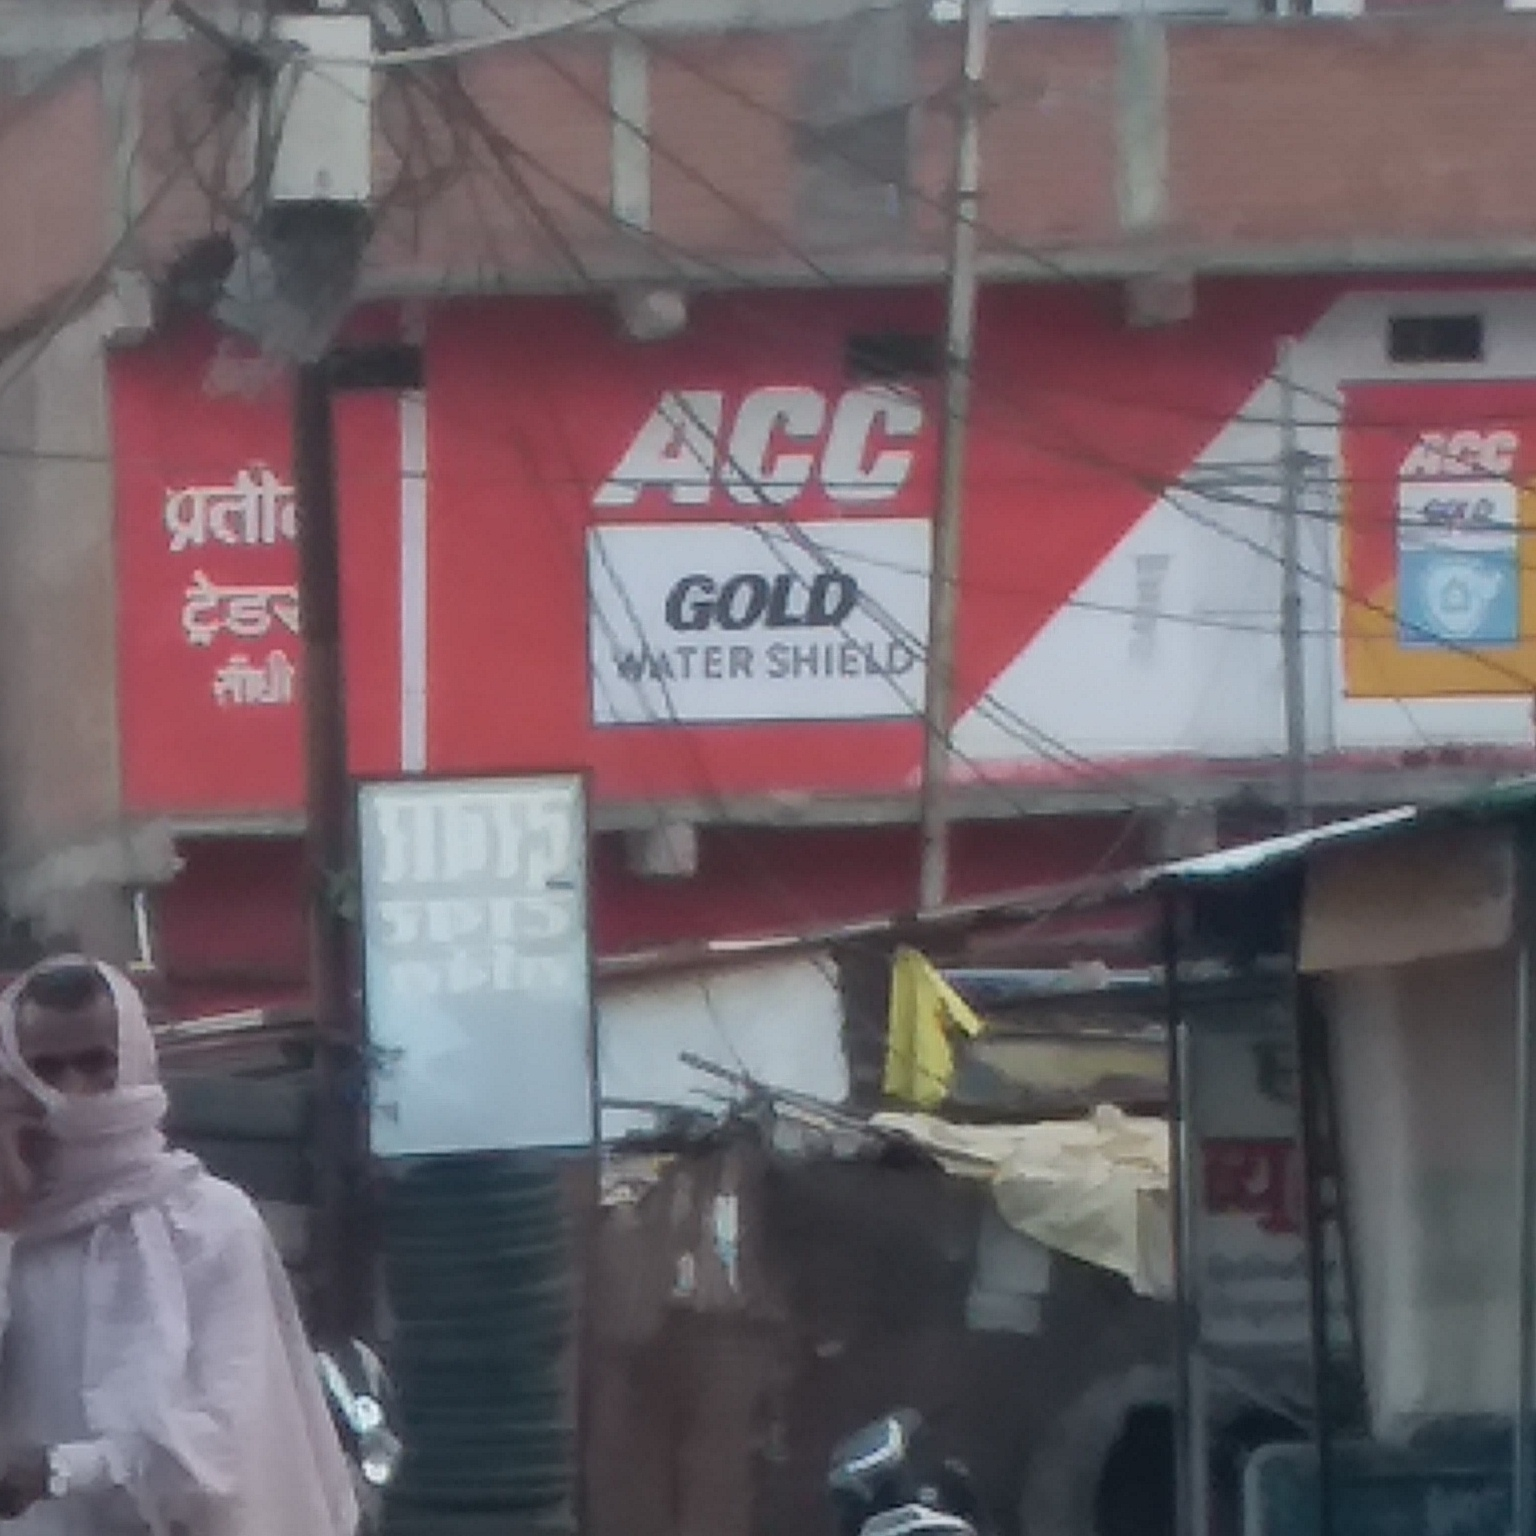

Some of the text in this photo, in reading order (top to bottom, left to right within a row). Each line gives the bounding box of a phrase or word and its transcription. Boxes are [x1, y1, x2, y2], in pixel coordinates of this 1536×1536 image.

[592, 385, 926, 507] ACC
[1399, 428, 1518, 478] ACC
[663, 572, 860, 632] GOLD
[615, 640, 916, 683] WATER SHIELD
